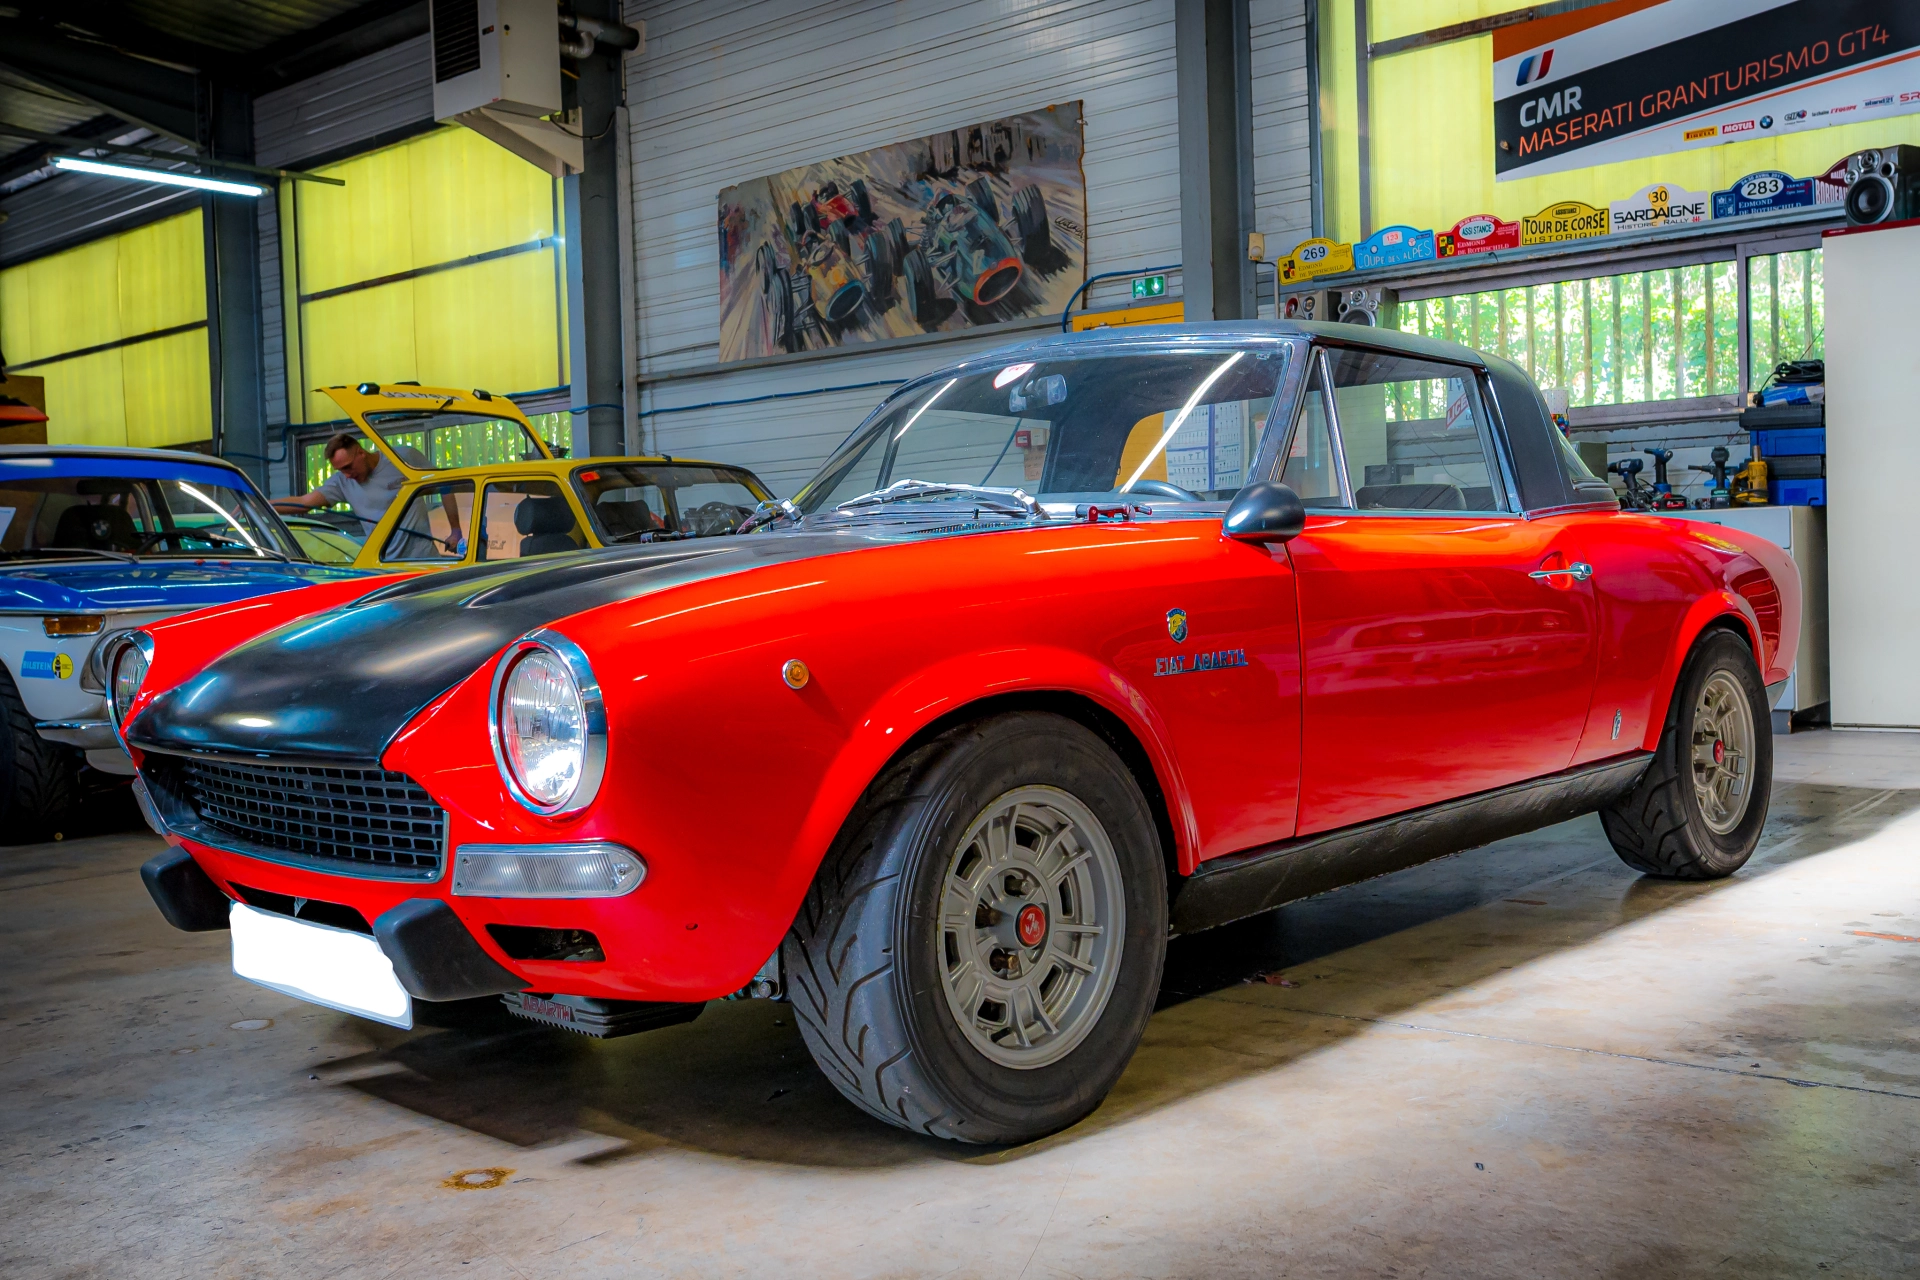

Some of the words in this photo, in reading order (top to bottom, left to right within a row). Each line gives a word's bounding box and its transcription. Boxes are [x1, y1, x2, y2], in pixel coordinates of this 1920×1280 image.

[1519, 101, 1633, 157] MASERATI
[1640, 40, 1829, 118] GRANTURISMO
[1838, 24, 1890, 57] GT4
[1520, 86, 1582, 128] CMR
[1724, 121, 1754, 133] MOTUL
[1747, 179, 1779, 196] 283
[1815, 179, 1848, 204] BORDEAU
[1652, 190, 1668, 203] 30
[1738, 198, 1773, 208] EDMOND
[1614, 202, 1705, 224] SARDAIGNE
[1751, 202, 1802, 214] ROTHSCHILD
[1524, 219, 1552, 235] TOUR
[1555, 220, 1568, 233] DE
[1571, 211, 1605, 231] CORSE
[1617, 221, 1658, 230] HISTORIC
[1386, 233, 1399, 242] 123
[1457, 240, 1486, 248] EDMOND
[1303, 246, 1326, 260] 269
[1358, 252, 1385, 268] COUPE
[1403, 240, 1432, 260] ALPES
[1467, 243, 1510, 254] ROTHSCHILD
[1299, 262, 1323, 271] EDMOND
[1155, 655, 1186, 675] FIAT
[1193, 648, 1247, 670] ABARTH
[522, 996, 571, 1022] ABARTH
